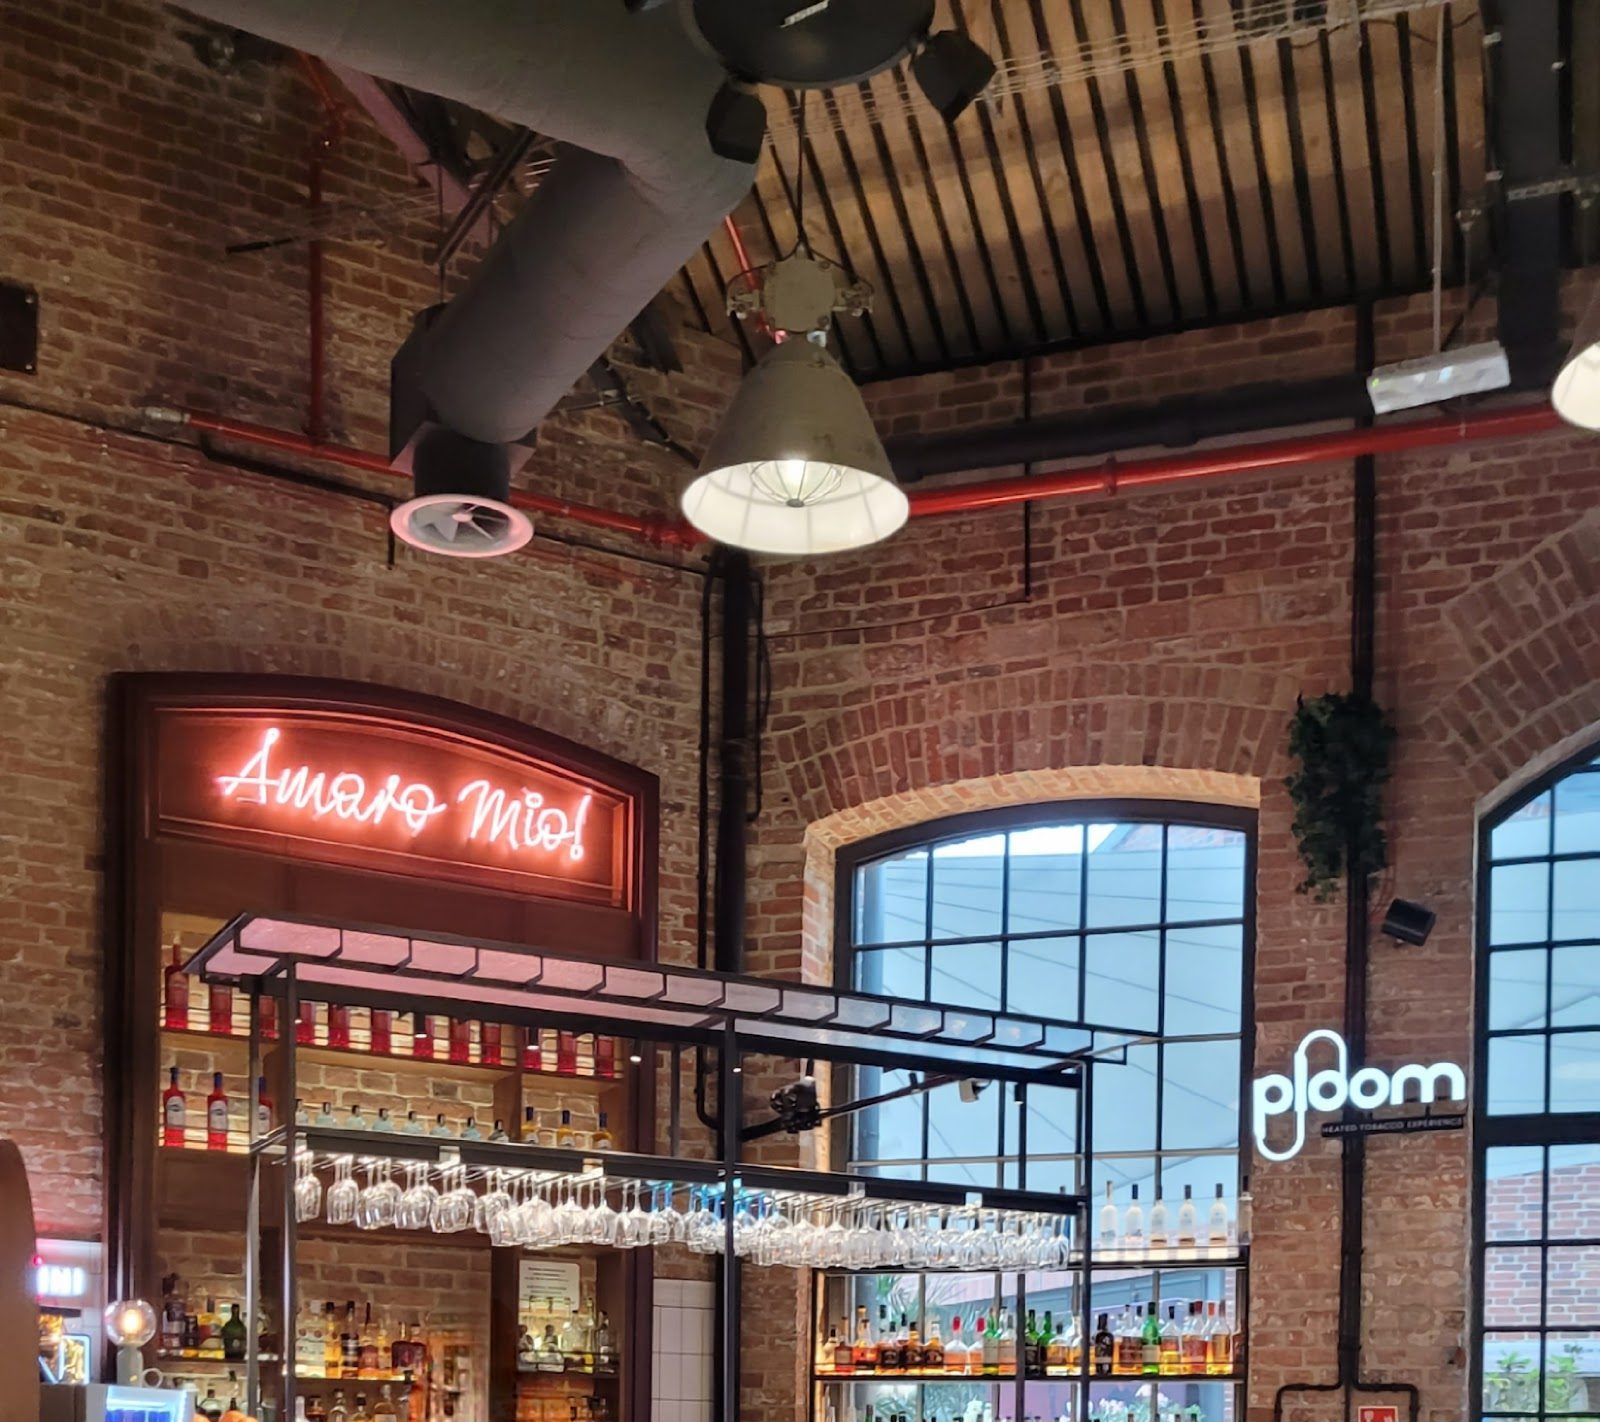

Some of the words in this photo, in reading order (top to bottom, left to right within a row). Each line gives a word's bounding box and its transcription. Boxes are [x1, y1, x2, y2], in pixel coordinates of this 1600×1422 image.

[215, 727, 447, 829] Amaro
[457, 780, 593, 861] Mio!
[1253, 1029, 1466, 1162] ploom
[1322, 1123, 1358, 1134] HEATED
[1359, 1121, 1405, 1132] TOBACCO
[1406, 1117, 1463, 1129] EXPERIENCE
